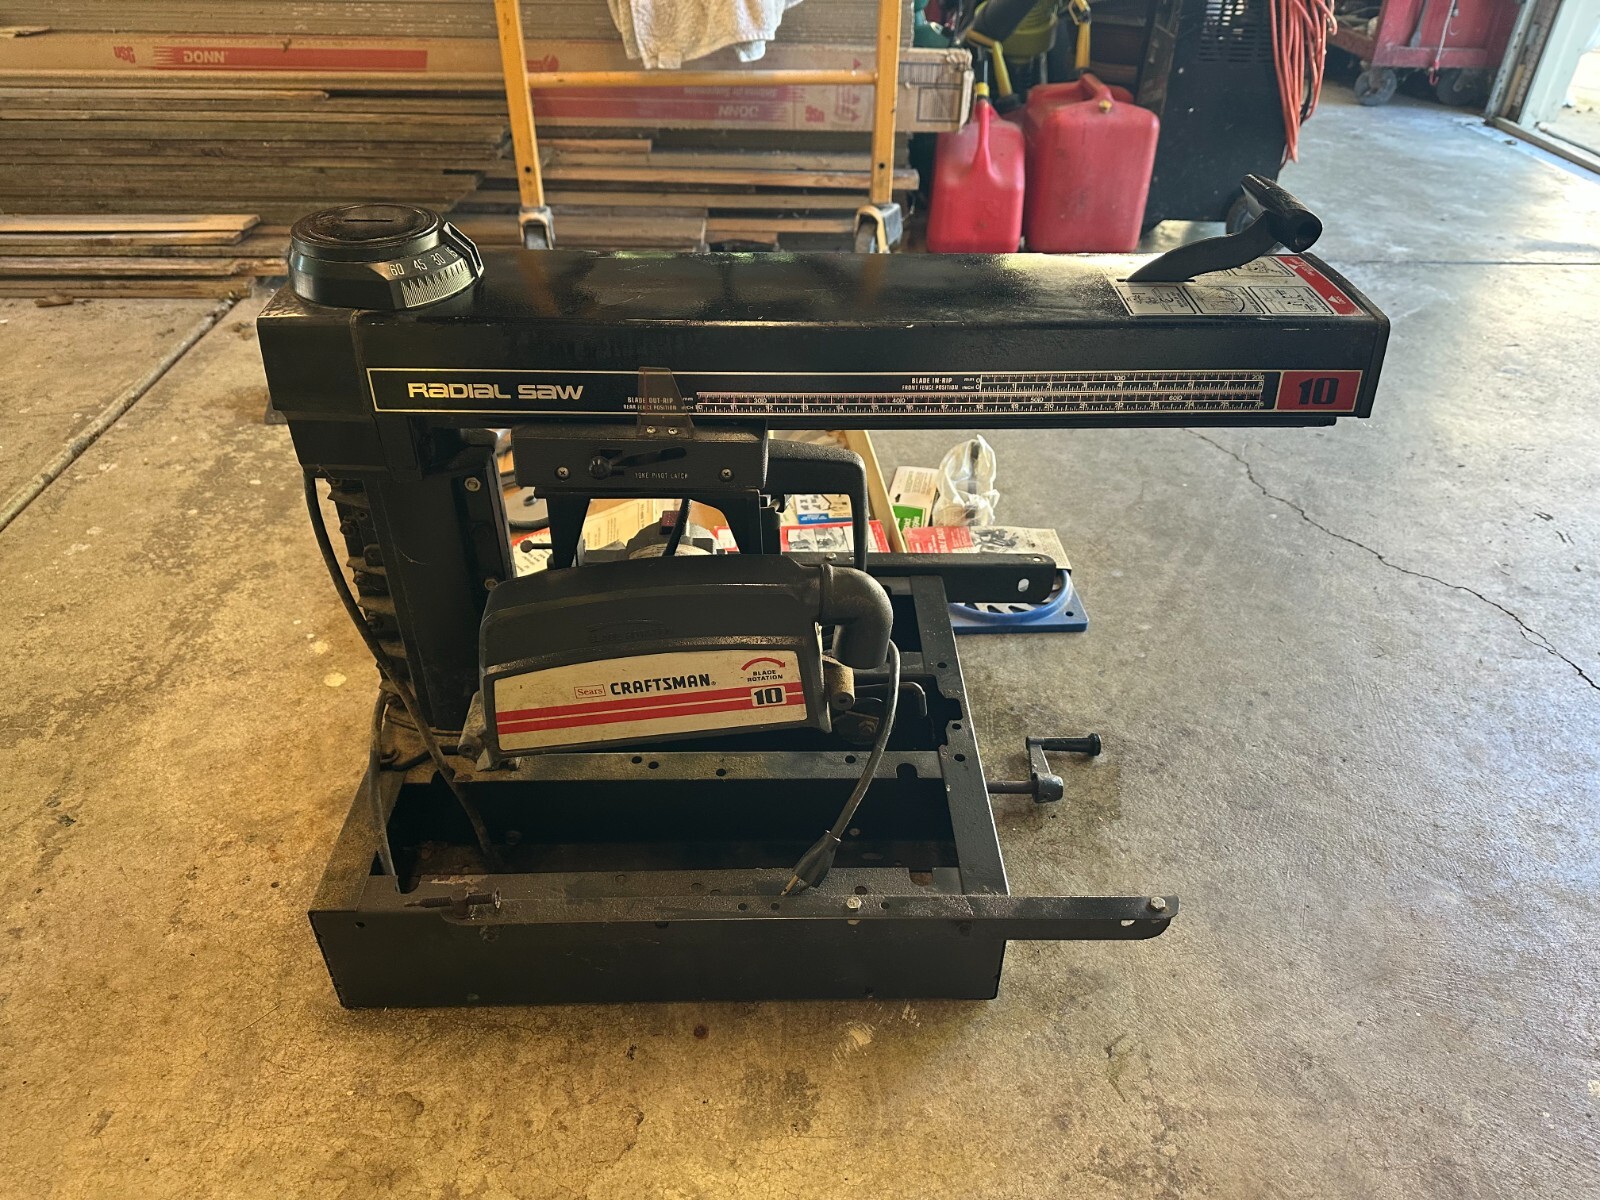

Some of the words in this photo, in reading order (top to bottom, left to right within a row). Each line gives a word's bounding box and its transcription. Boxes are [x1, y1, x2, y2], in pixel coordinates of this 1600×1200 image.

[389, 263, 405, 276] 60
[413, 258, 428, 272] 45
[430, 252, 446, 266] 30
[407, 382, 512, 399] RADIAL
[517, 384, 584, 400] SAW
[1298, 377, 1341, 406] 10
[627, 396, 647, 404] BLADE
[747, 674, 784, 683] ROTATION
[752, 669, 777, 677] BLADE
[577, 687, 603, 696] Sears
[753, 687, 783, 706] 10
